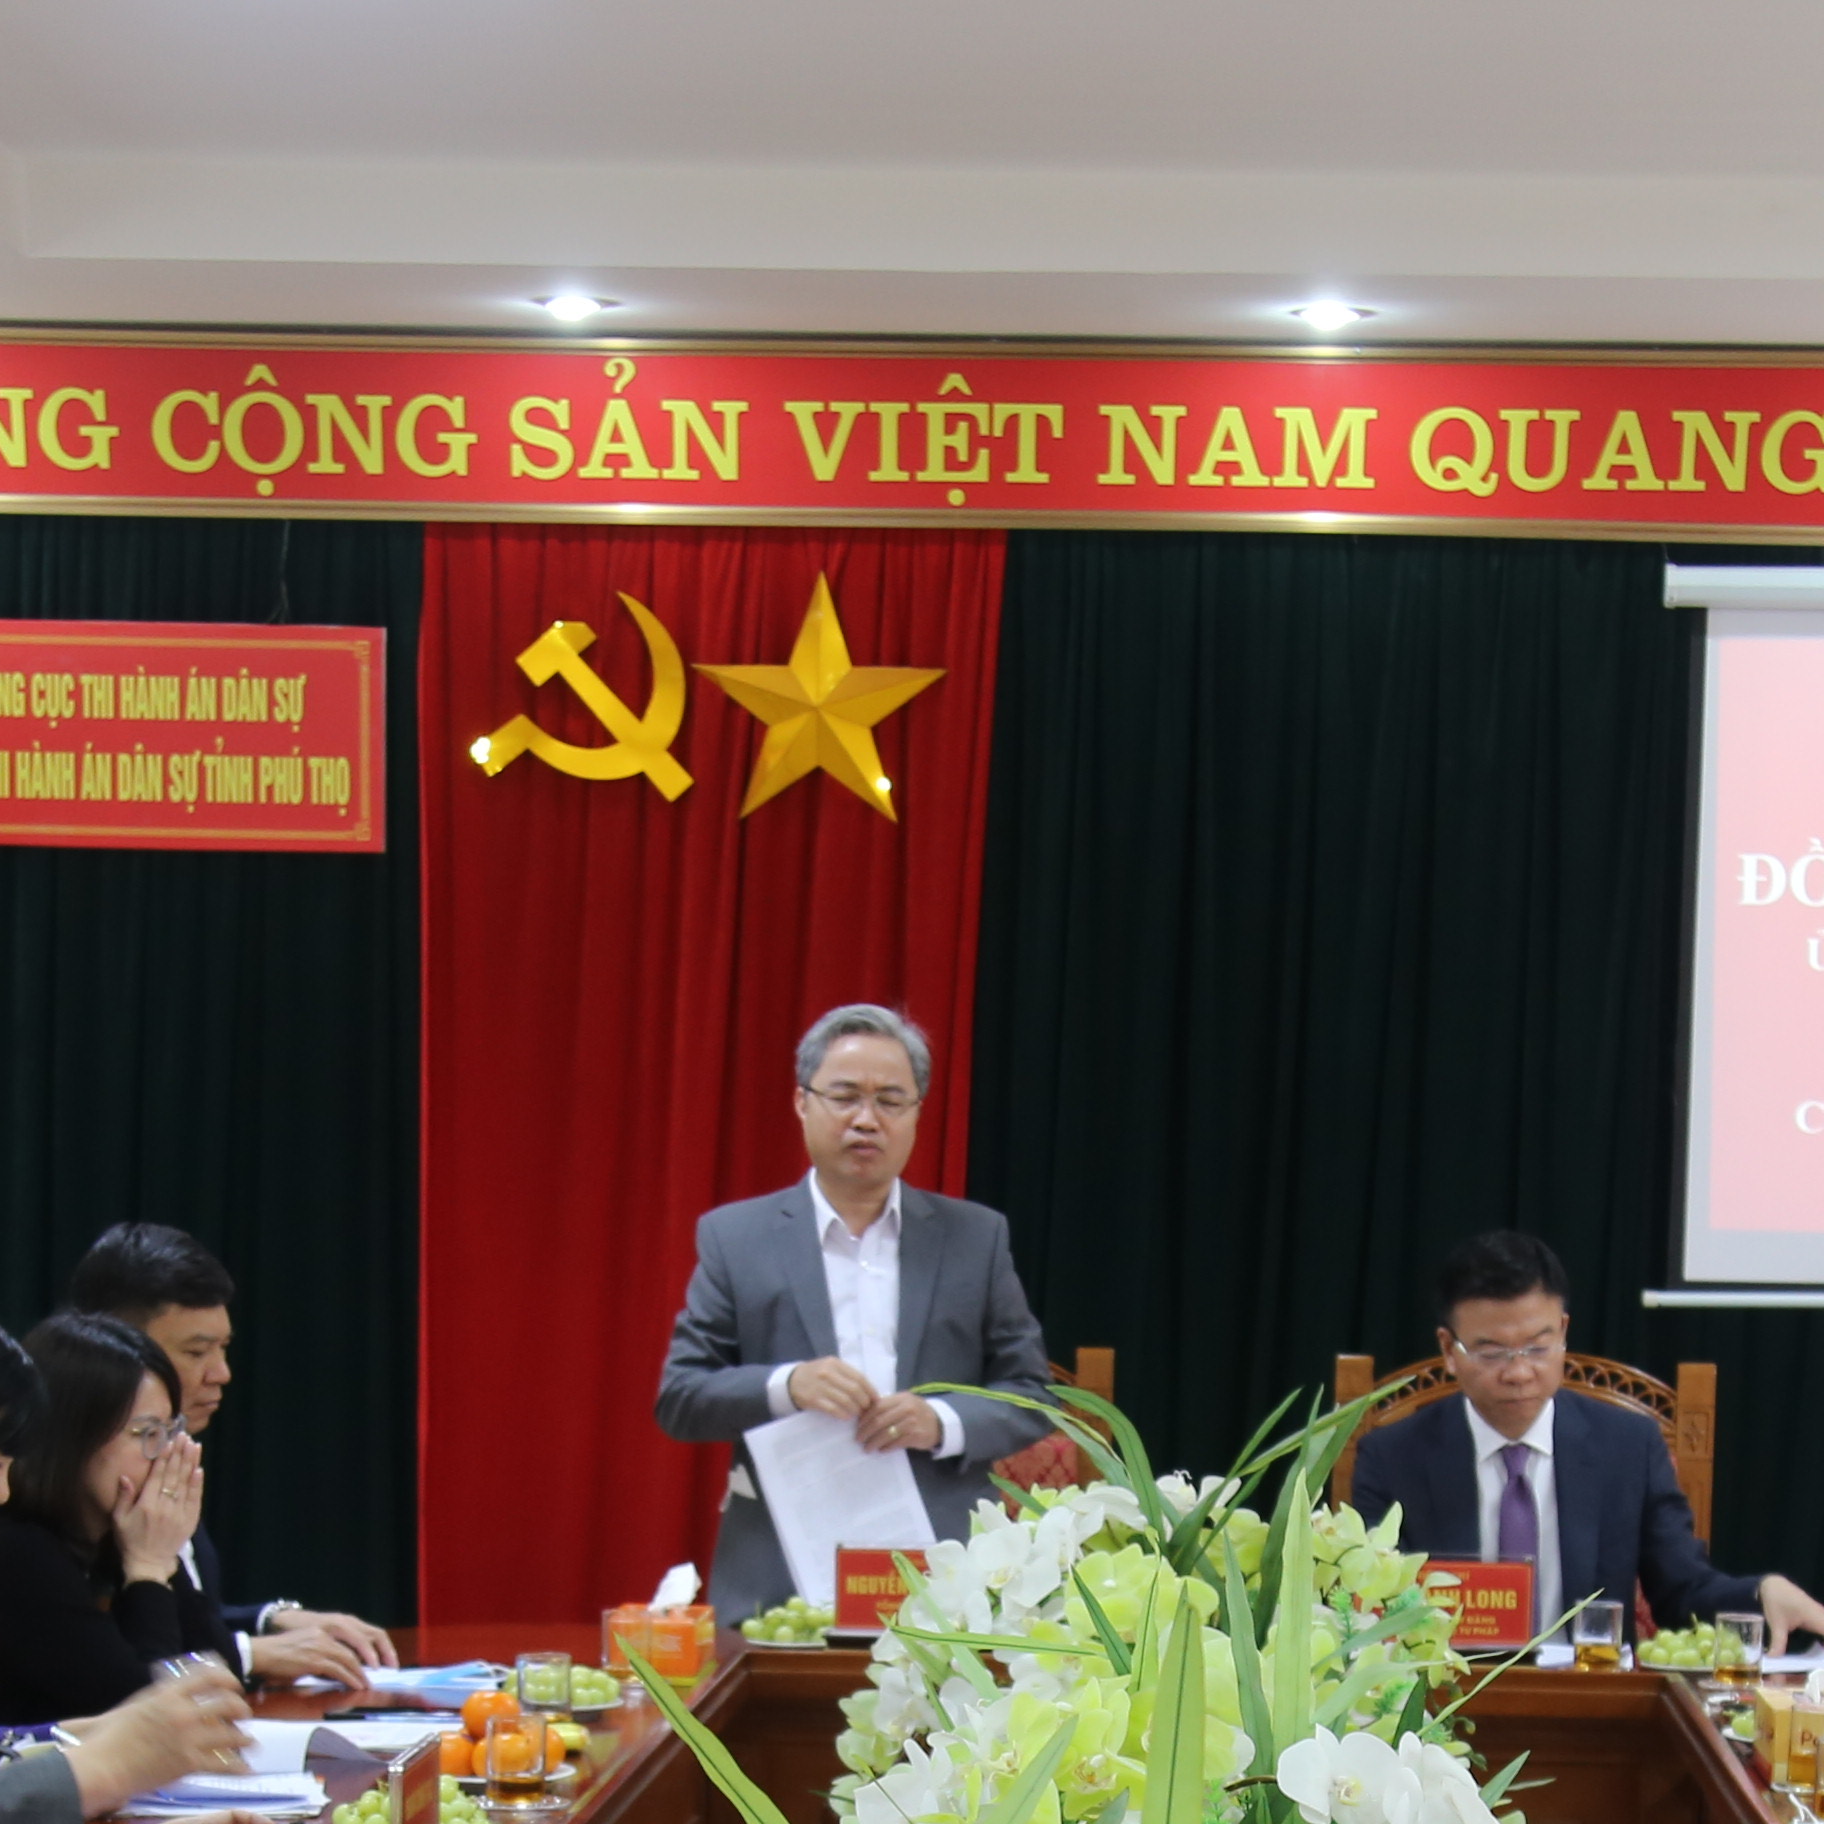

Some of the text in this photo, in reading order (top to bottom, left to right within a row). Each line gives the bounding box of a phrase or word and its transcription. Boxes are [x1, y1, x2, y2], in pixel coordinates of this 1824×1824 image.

[151, 364, 479, 497] CỘNG
[508, 352, 750, 482] SẢN
[783, 373, 1064, 507] VIỆT
[1096, 404, 1380, 490] NAM
[31, 673, 74, 729] CỤC
[81, 674, 115, 719] THI
[120, 665, 181, 720] HÀNH
[186, 667, 217, 721] ÁN
[223, 668, 269, 722] DÂN
[274, 674, 307, 733] SỰ
[15, 741, 76, 801] HÀNH
[81, 742, 113, 801] ÁN
[118, 743, 164, 803] DÂN
[169, 750, 202, 814] SỰ
[204, 737, 254, 804] TỈNH
[260, 747, 304, 805] PHÚ
[309, 757, 352, 818] THỌ
[1466, 1589, 1518, 1610] LONG
